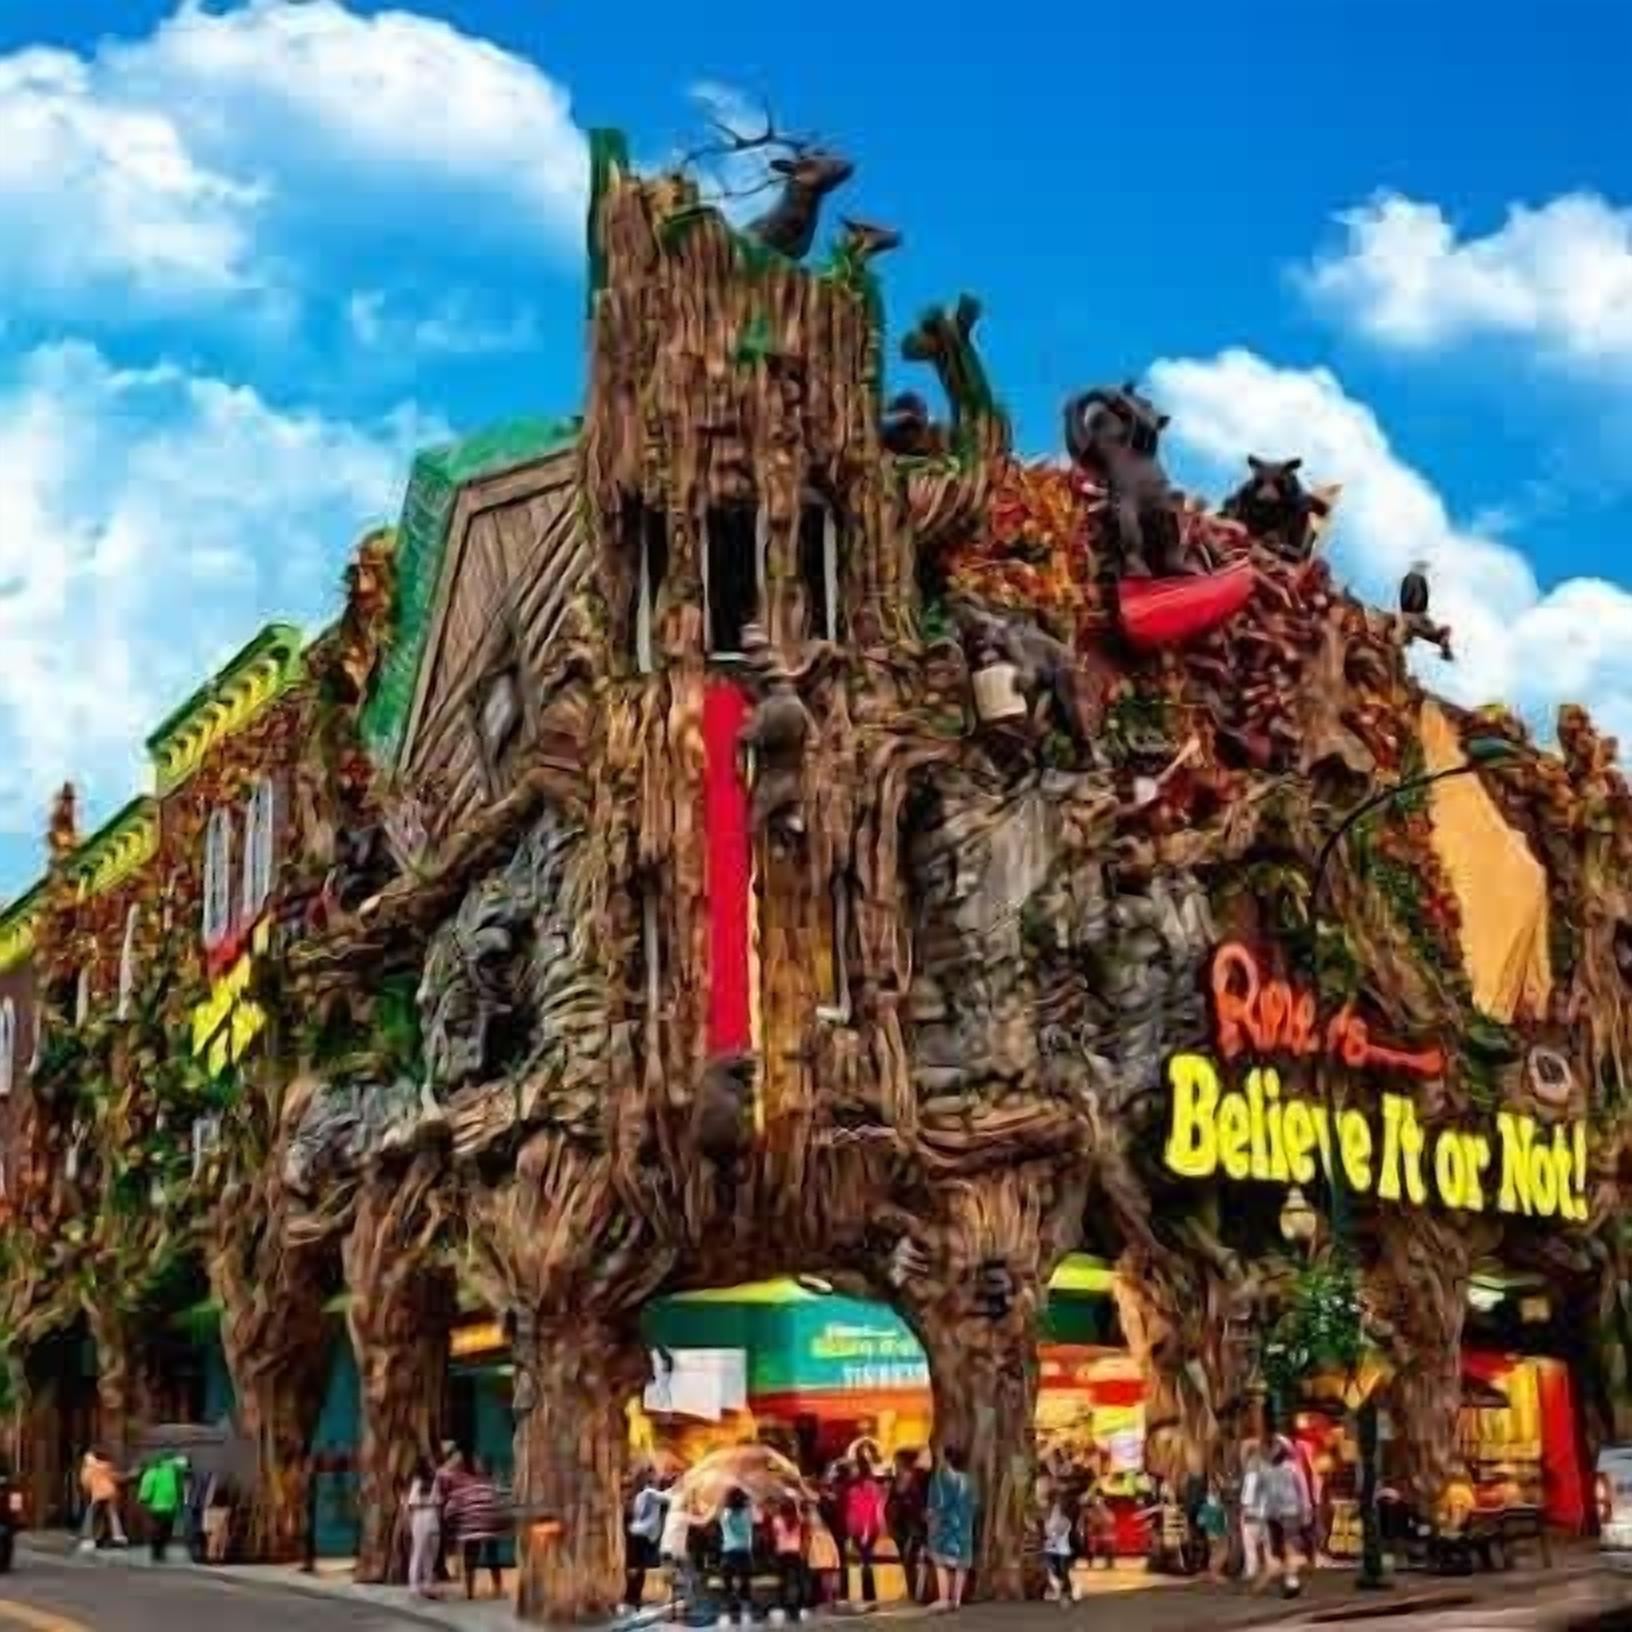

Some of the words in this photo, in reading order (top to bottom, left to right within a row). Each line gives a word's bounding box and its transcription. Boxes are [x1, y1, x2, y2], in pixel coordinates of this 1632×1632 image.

[1164, 1053, 1372, 1191] Believe
[1378, 1093, 1427, 1205] It
[1435, 1130, 1492, 1212] or
[1496, 1112, 1589, 1221] Not!
